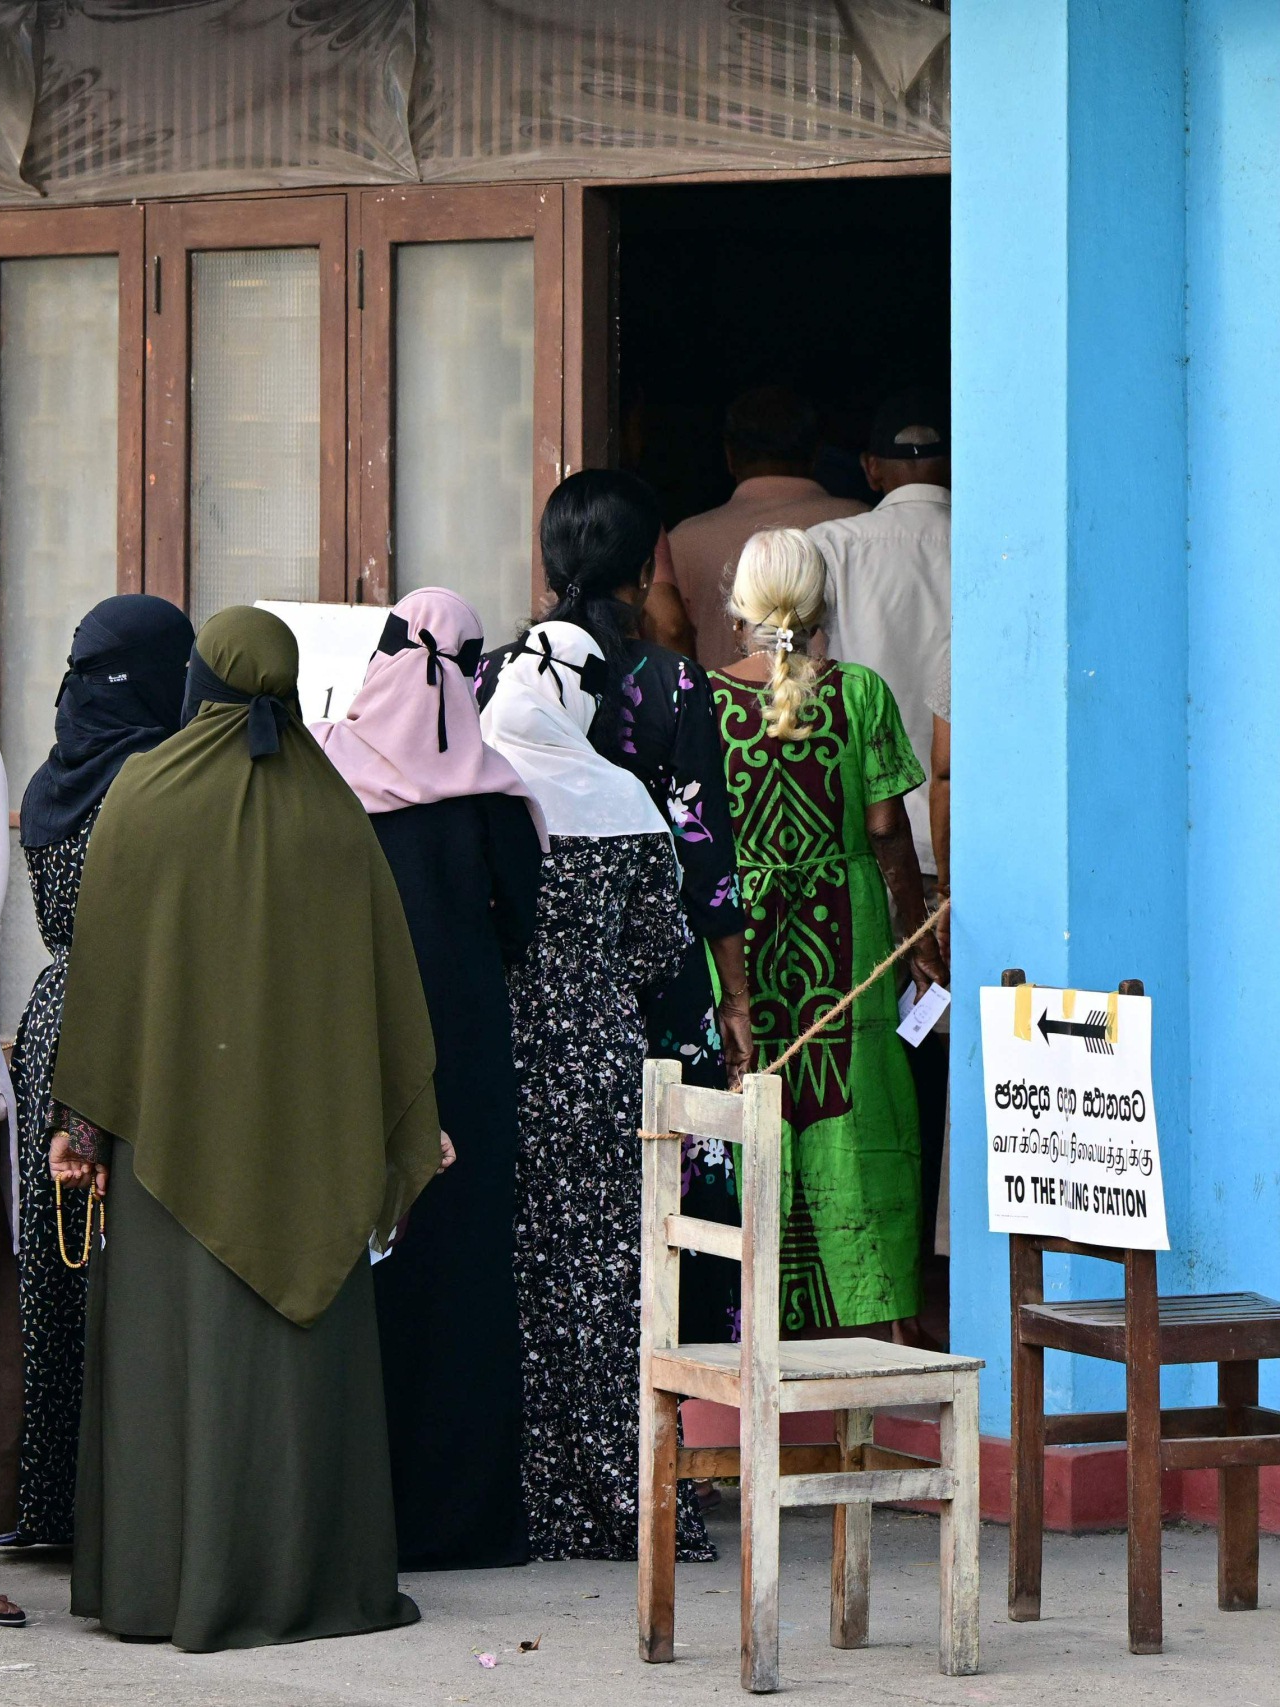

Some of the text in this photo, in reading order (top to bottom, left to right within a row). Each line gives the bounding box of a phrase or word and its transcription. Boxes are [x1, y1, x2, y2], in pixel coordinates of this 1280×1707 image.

[321, 686, 333, 719] 1
[994, 1078, 1051, 1119] ඡන්දය
[1004, 1175, 1025, 1203] TO
[1031, 1176, 1056, 1205] THE
[1093, 1185, 1147, 1218] STATION
